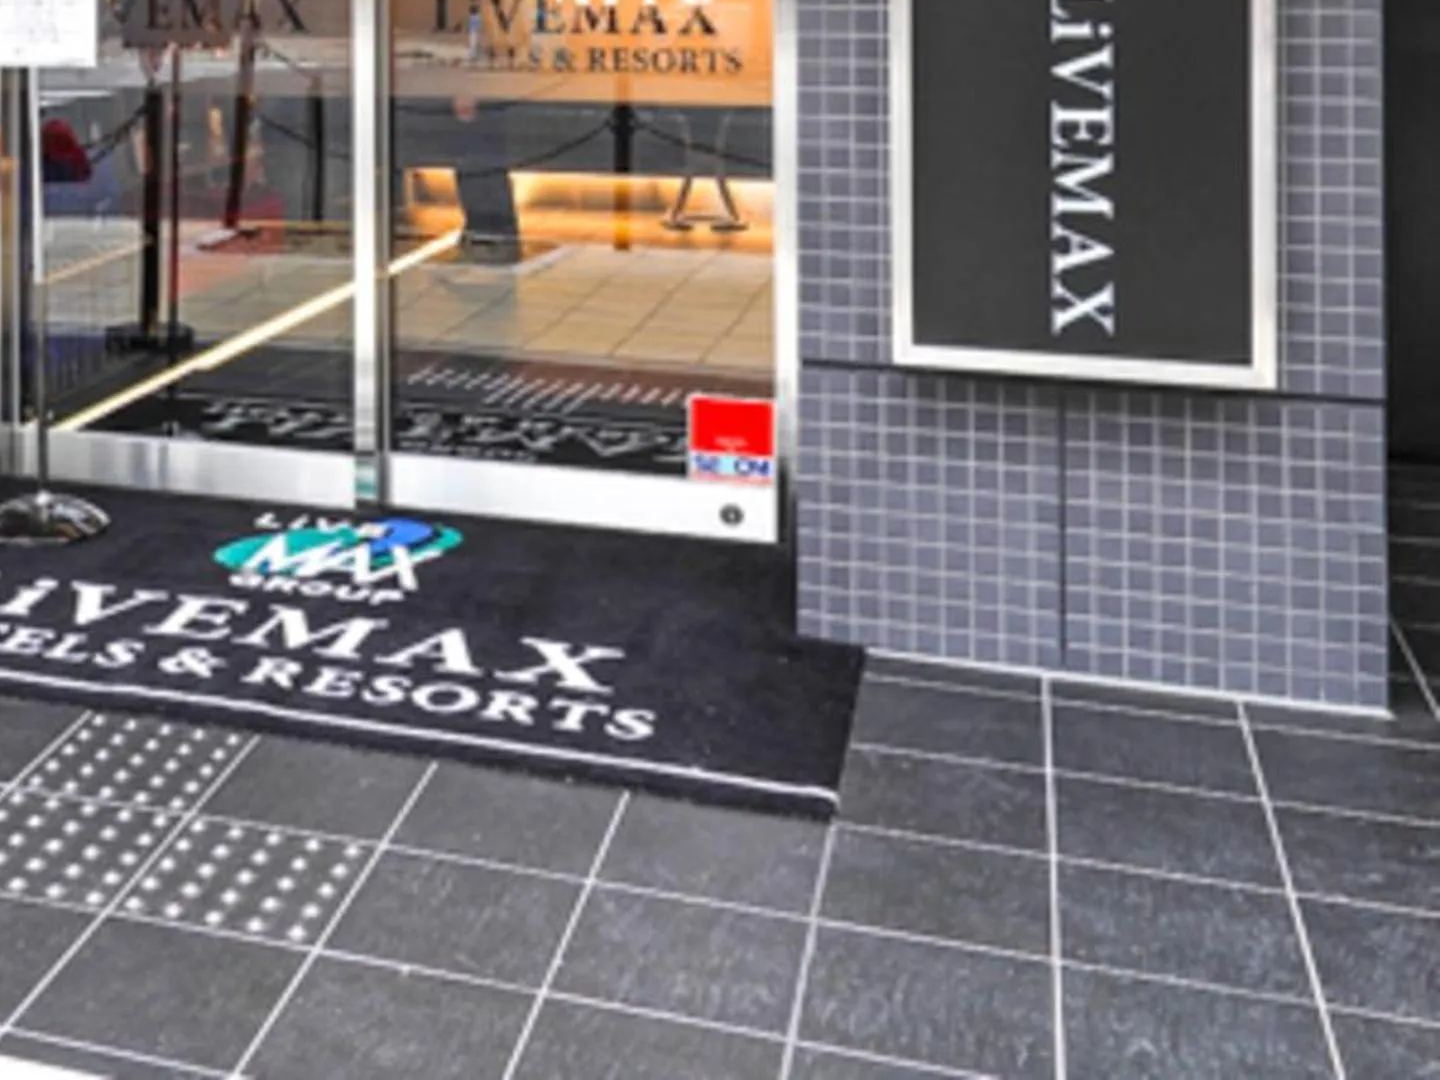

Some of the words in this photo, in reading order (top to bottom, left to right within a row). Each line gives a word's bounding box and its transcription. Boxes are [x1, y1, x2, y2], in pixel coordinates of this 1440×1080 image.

[587, 47, 744, 74] RESORTS
[243, 533, 445, 592] MAX
[229, 574, 405, 606] GROUP
[158, 646, 229, 678] &
[240, 656, 657, 741] RESORTS
